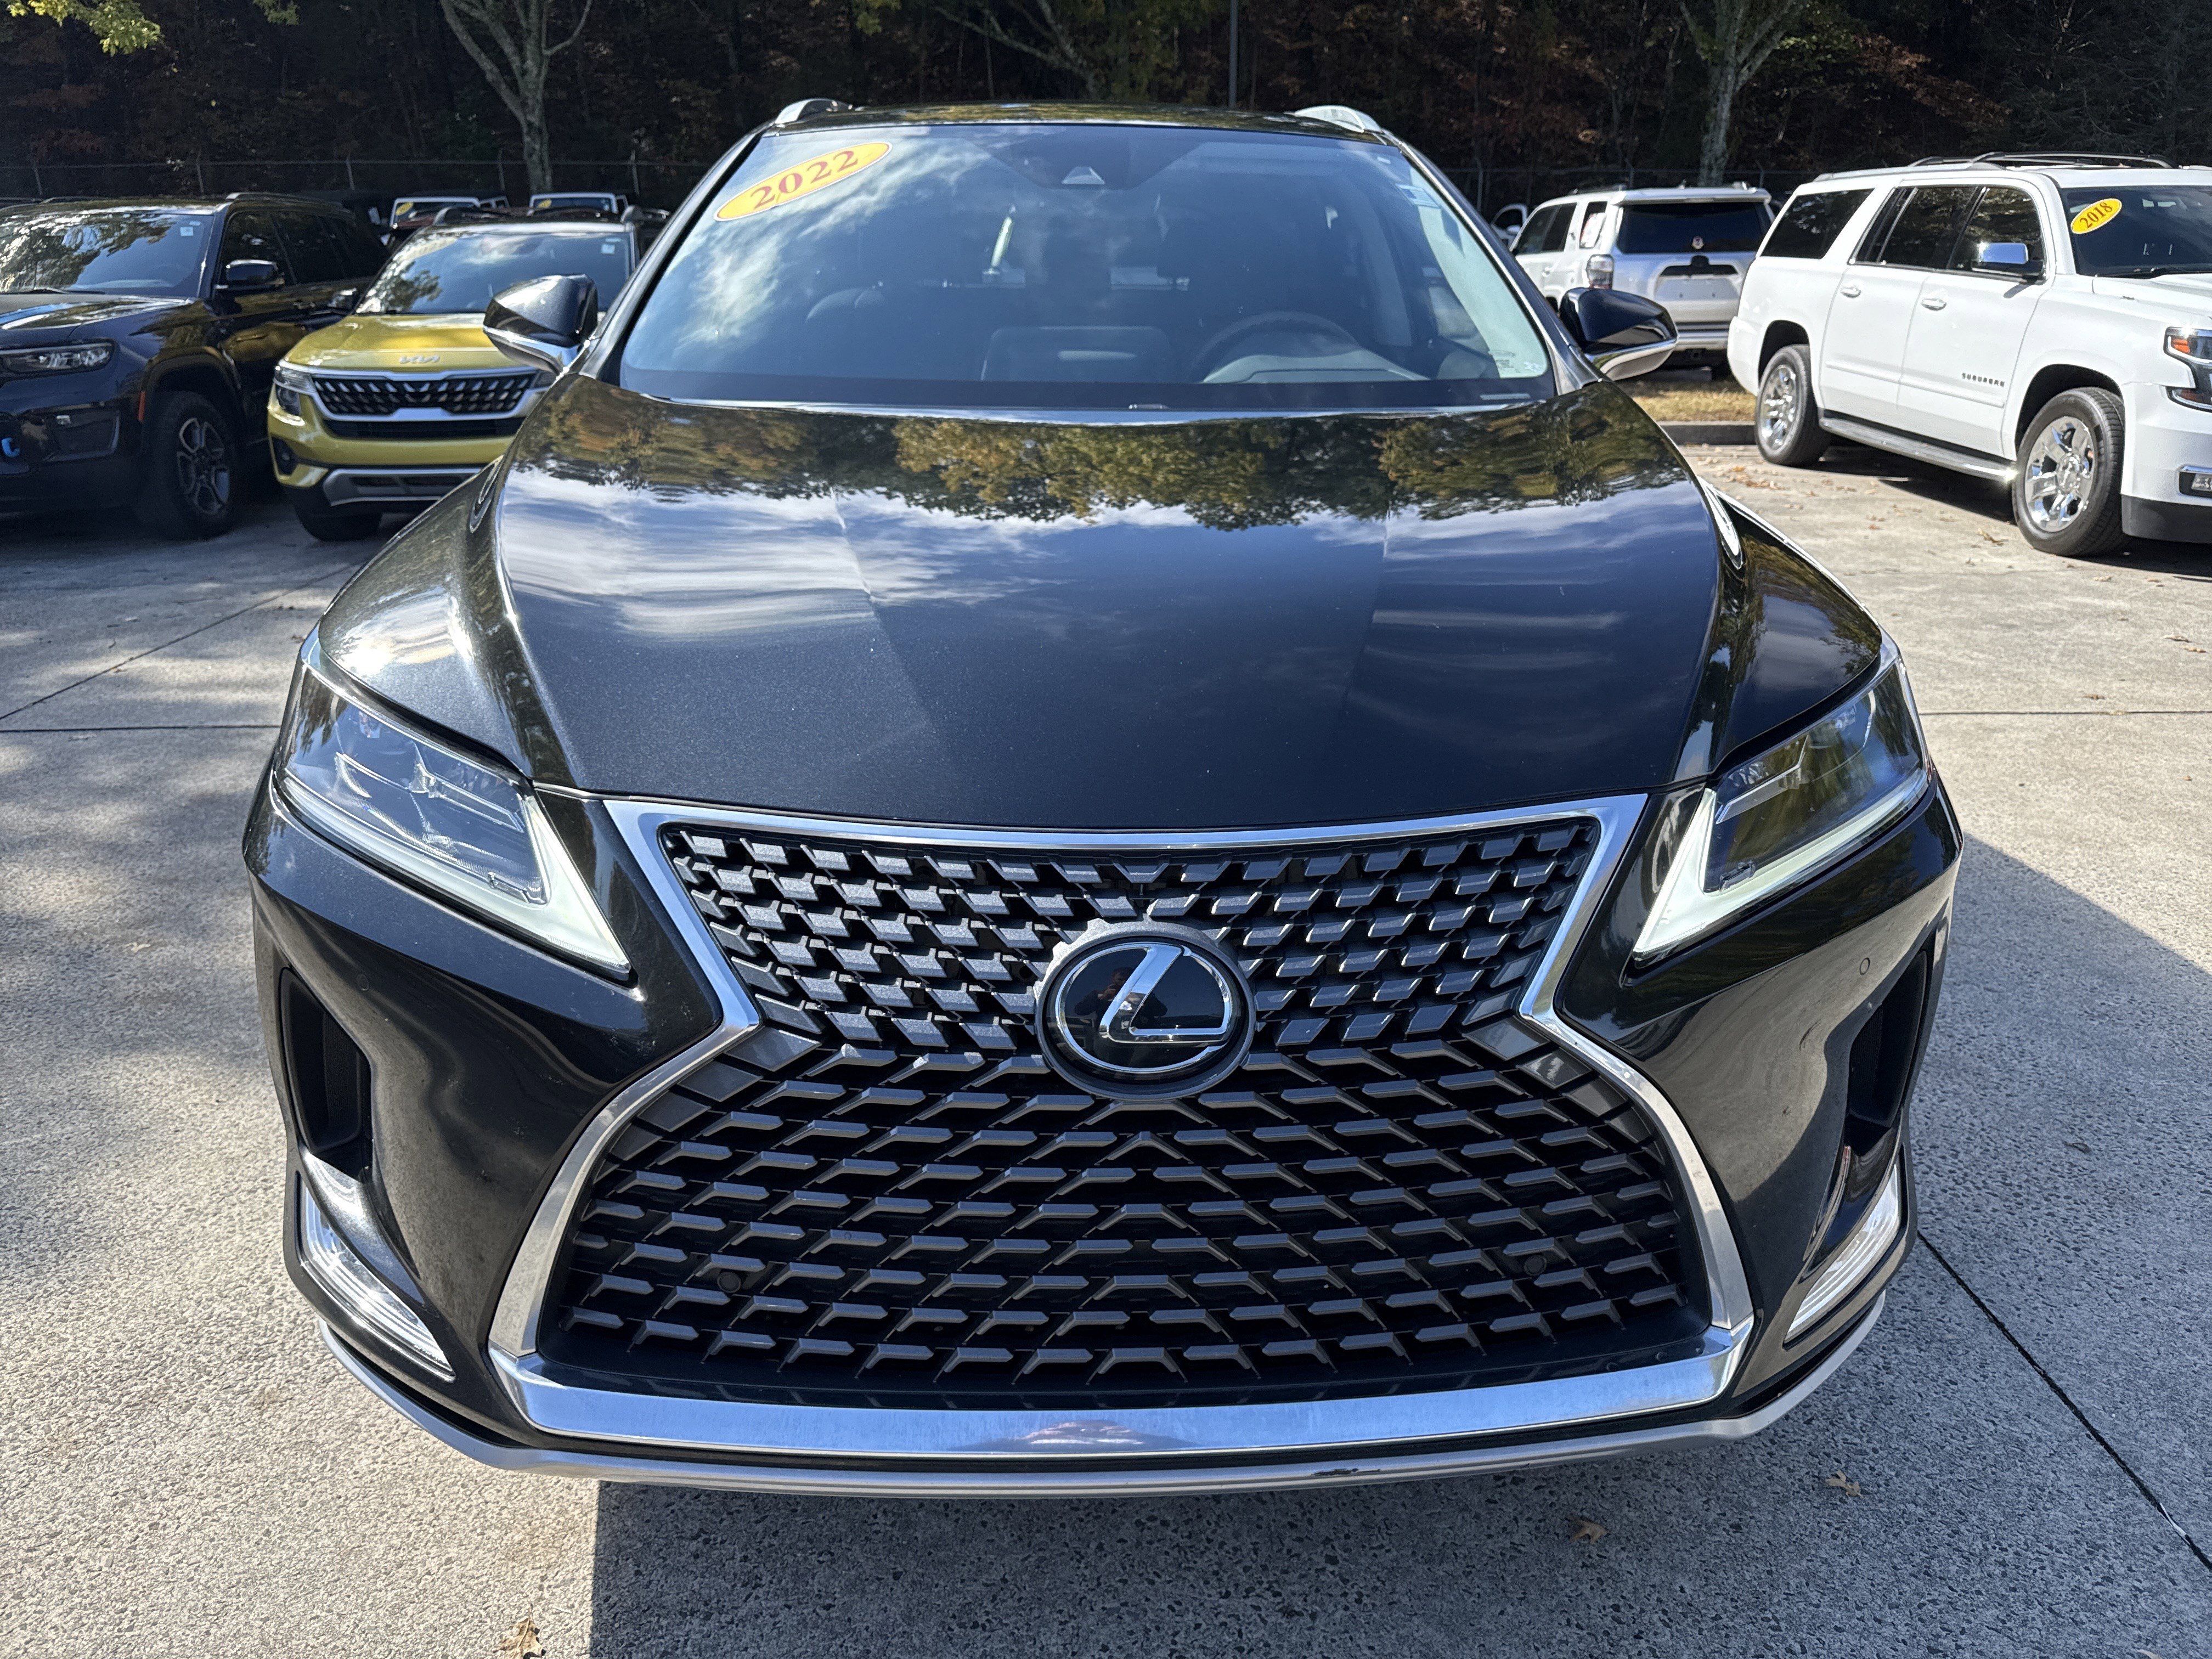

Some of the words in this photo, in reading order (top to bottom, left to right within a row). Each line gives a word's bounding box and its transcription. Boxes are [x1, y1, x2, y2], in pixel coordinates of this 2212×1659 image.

[751, 150, 859, 210] 2022
[2079, 201, 2113, 229] 2018
[1962, 373, 2005, 387] SUBURBAN
